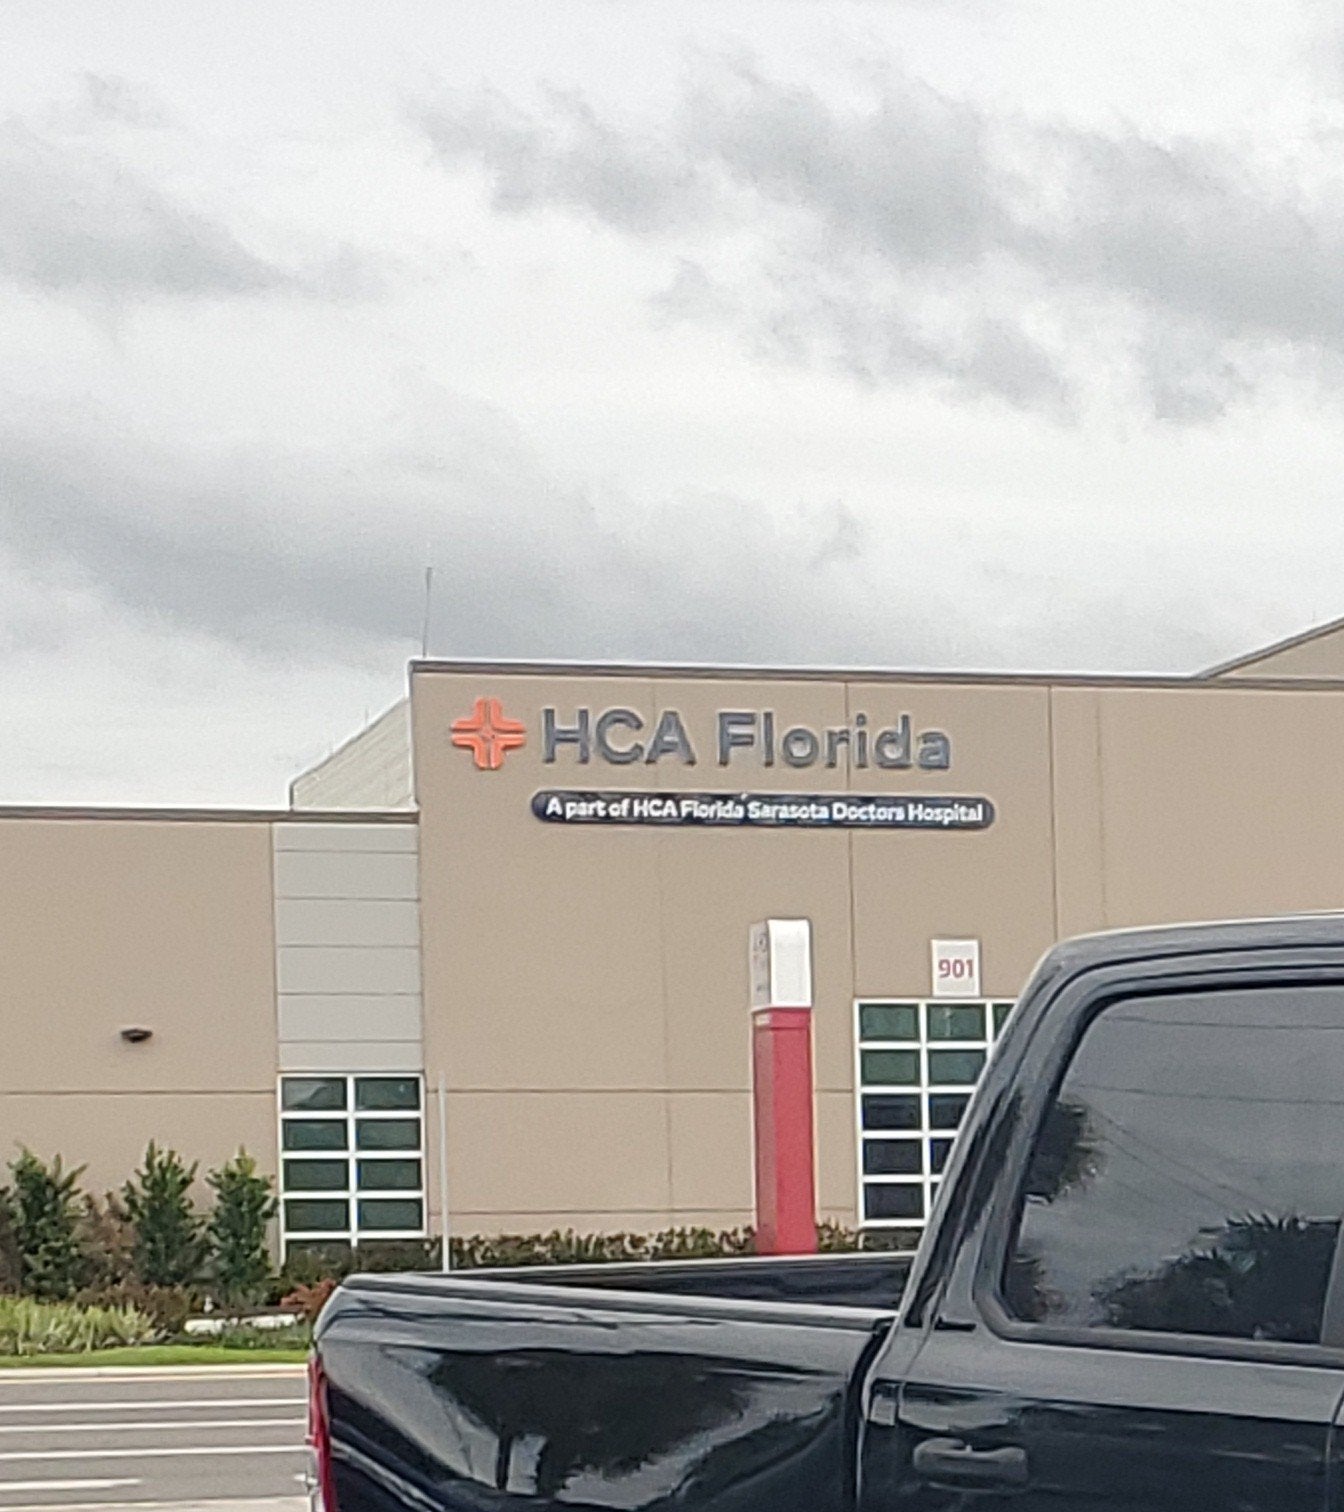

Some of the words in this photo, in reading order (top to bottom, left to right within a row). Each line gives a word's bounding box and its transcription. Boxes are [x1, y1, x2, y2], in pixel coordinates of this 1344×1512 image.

[541, 707, 697, 766] HCA
[717, 711, 952, 770] Florida
[546, 796, 563, 816] A
[565, 799, 607, 820] part
[608, 797, 629, 818] of
[633, 798, 678, 818] HCA
[680, 799, 743, 820] Florida
[747, 801, 829, 821] Sarasota
[831, 802, 905, 822] Doctors
[908, 803, 984, 825] Hospital
[938, 958, 973, 979] 901
